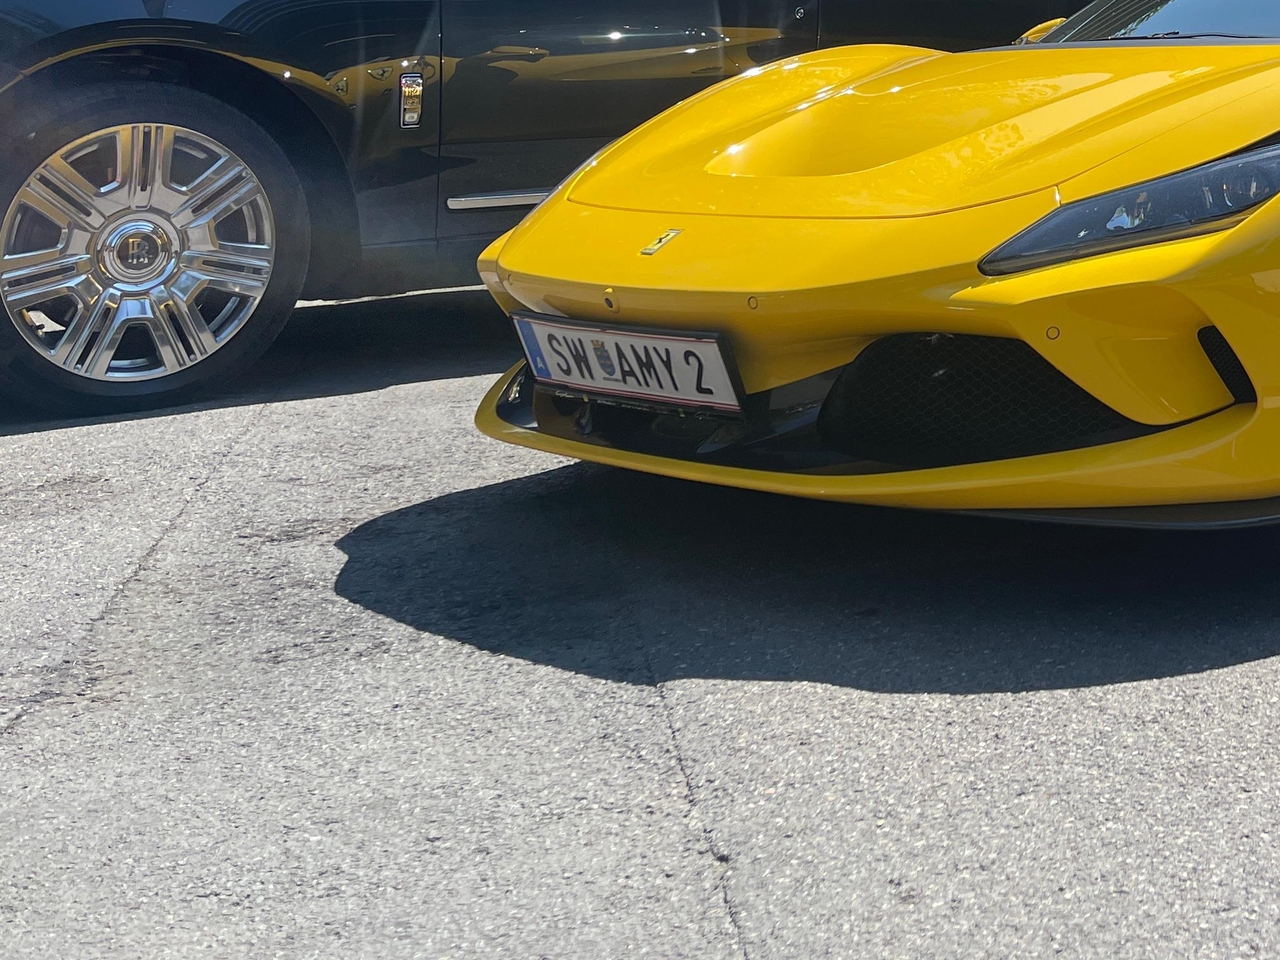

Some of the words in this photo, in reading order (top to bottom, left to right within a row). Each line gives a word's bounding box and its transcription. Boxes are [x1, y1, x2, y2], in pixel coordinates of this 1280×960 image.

[547, 333, 594, 381] SW
[614, 342, 679, 391] AMY
[683, 349, 713, 395] 2
